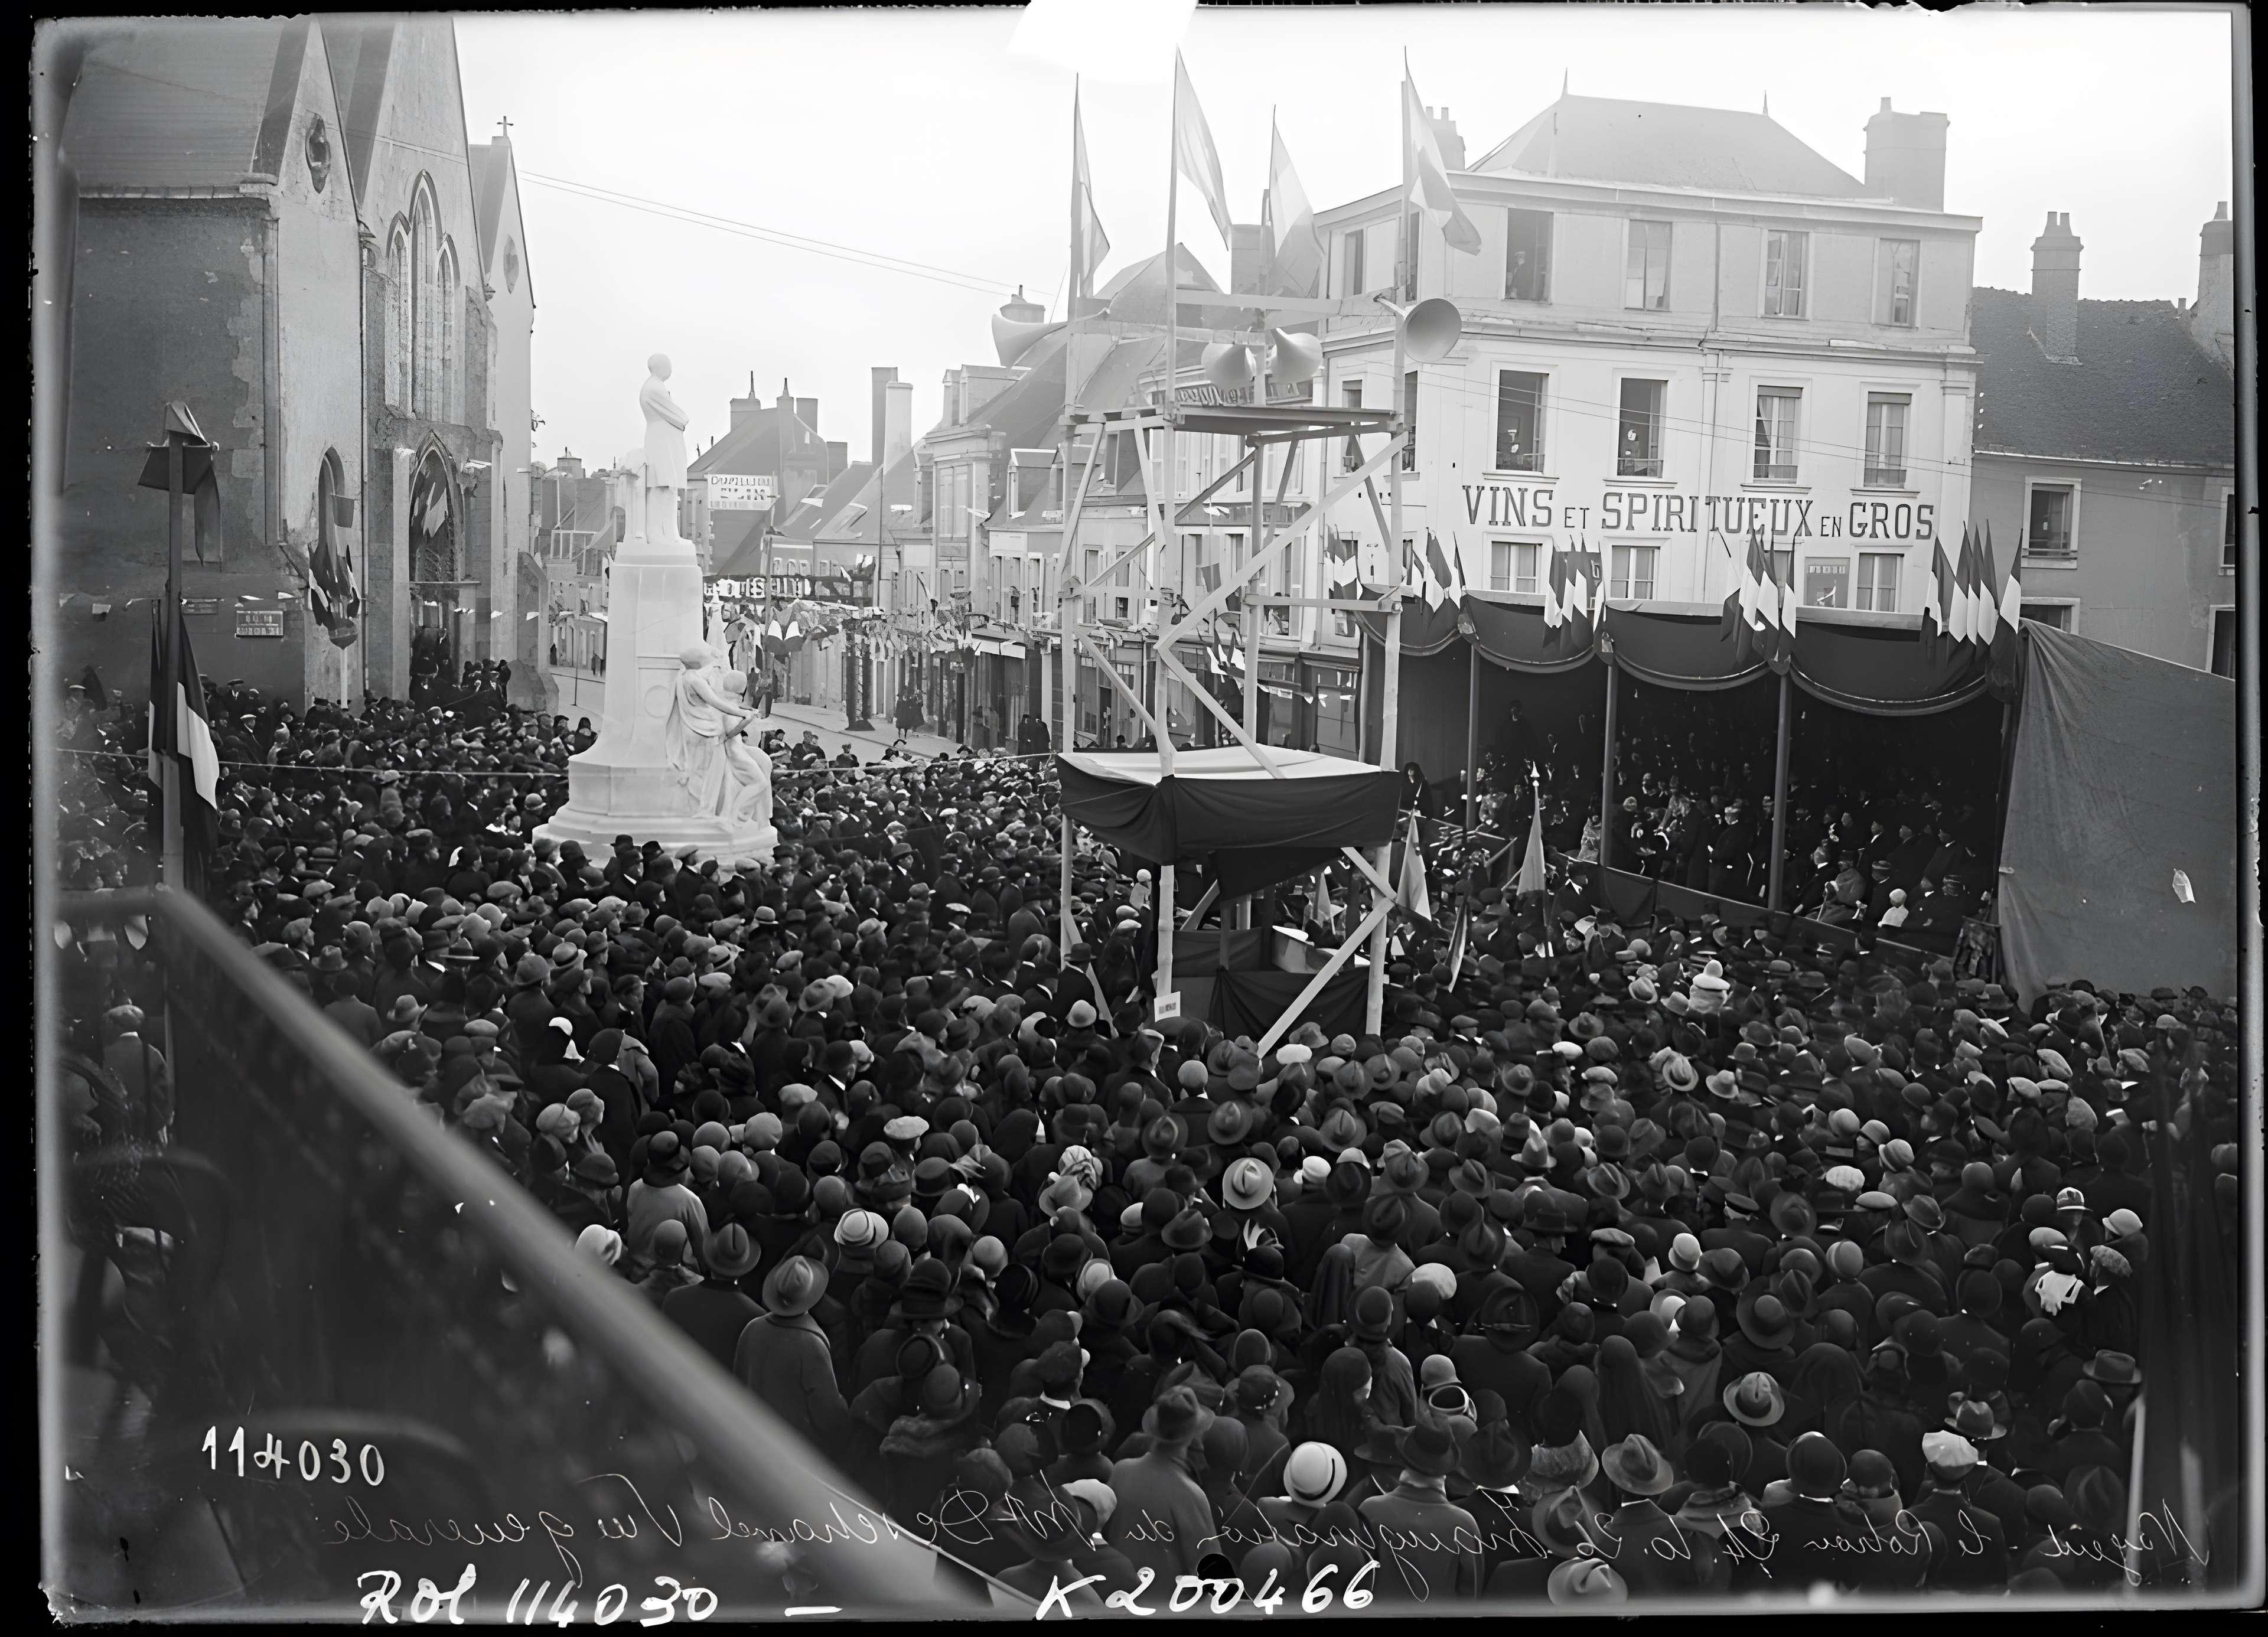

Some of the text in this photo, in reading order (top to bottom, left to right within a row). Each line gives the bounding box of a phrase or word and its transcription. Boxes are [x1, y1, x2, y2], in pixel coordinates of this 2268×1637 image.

[1461, 484, 1935, 541] VINS ET SPIRITUEUX EN GROS
